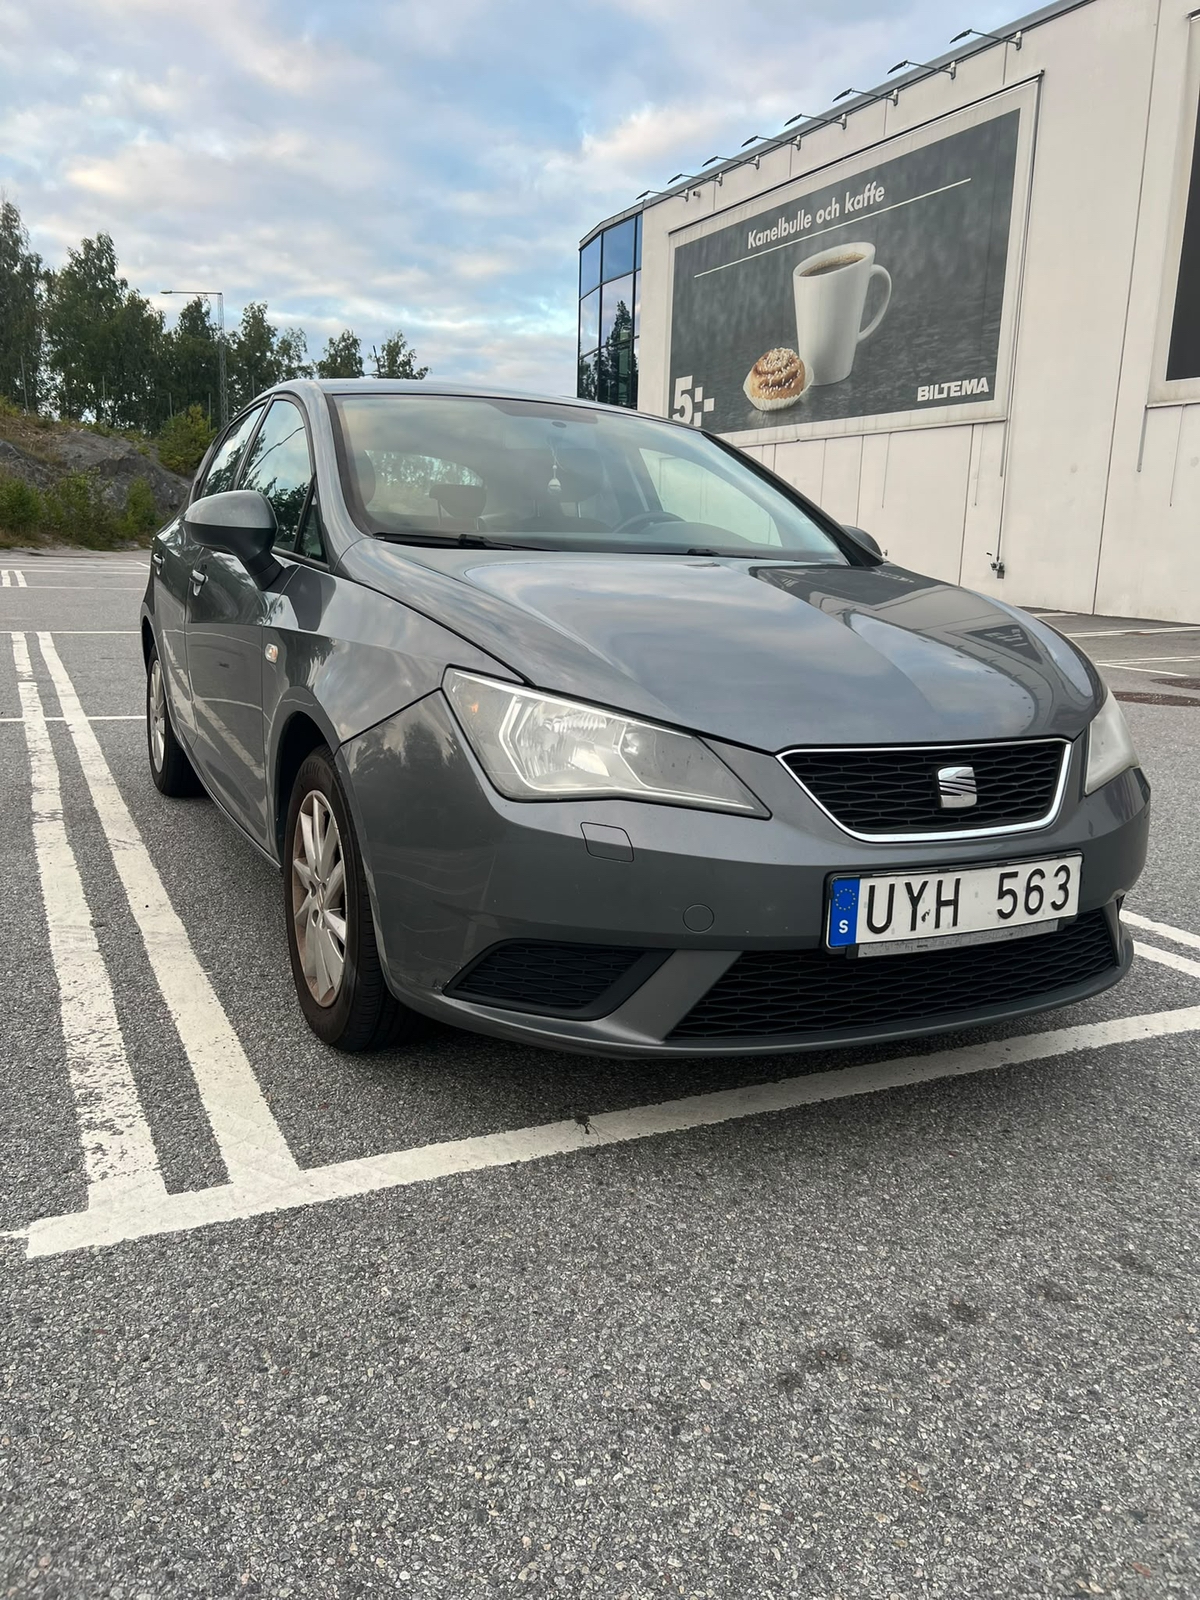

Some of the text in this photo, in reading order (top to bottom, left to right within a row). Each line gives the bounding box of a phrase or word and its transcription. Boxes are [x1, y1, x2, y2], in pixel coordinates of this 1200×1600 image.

[747, 181, 885, 249] Kanelbulle och kaffe
[916, 377, 989, 402] BILTEMA
[866, 864, 1072, 934] UYH 563
[838, 919, 849, 934] S
